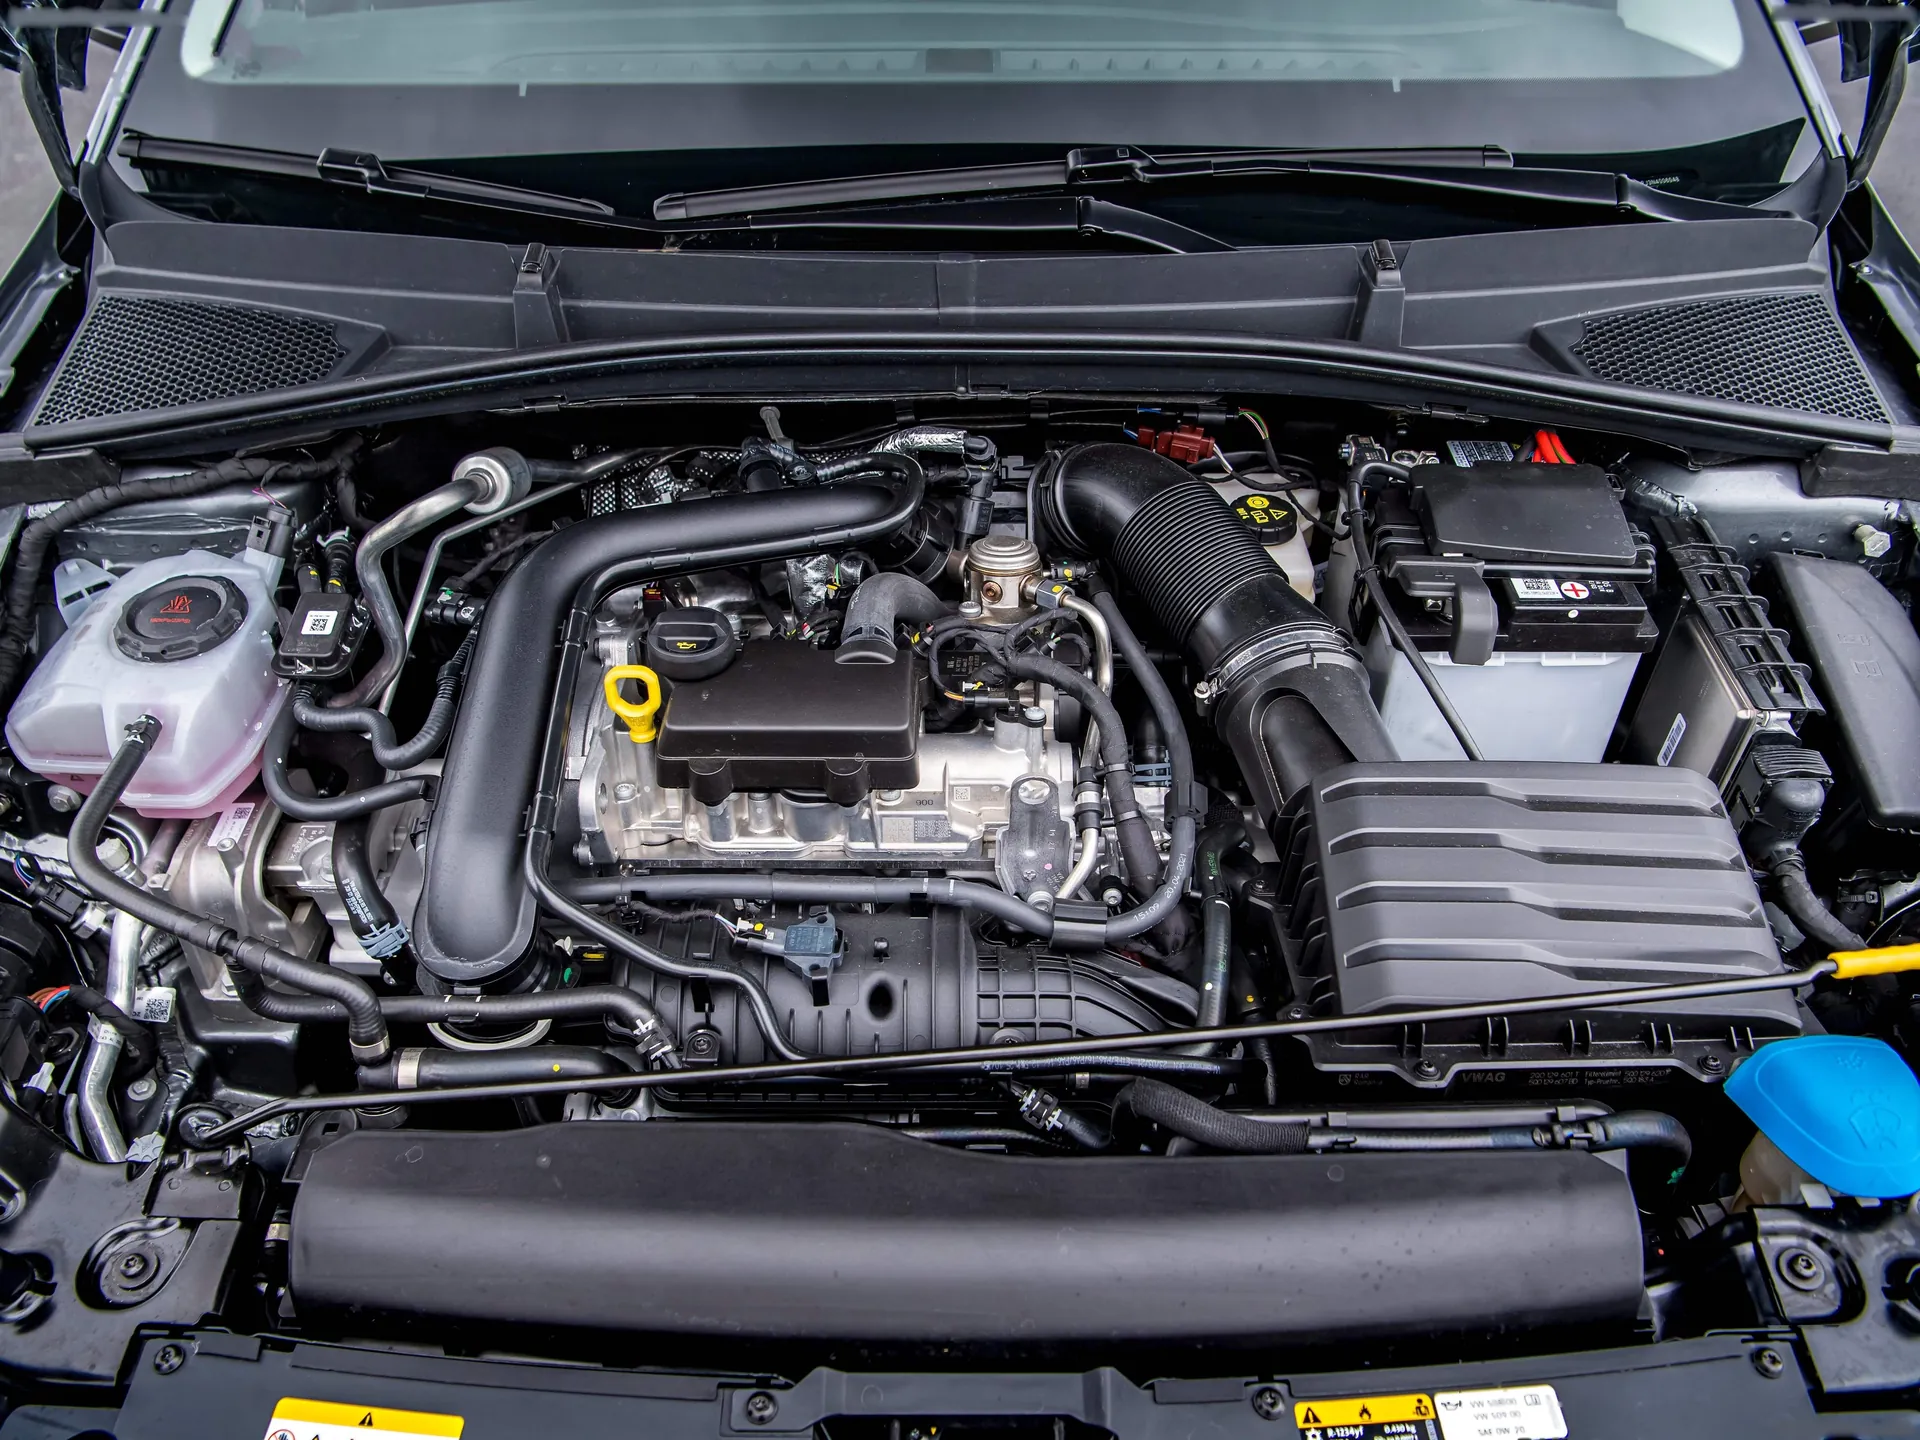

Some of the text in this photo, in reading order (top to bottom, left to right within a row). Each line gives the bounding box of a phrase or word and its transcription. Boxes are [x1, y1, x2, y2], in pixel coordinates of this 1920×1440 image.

[1133, 902, 1160, 922] 15:09
[1164, 853, 1187, 899] 20.04.2021
[1461, 1072, 1506, 1083] VWAG
[1469, 1400, 1485, 1408] VW
[1473, 1411, 1489, 1420] VW
[1326, 1425, 1364, 1438] R-1234yf
[1406, 1423, 1417, 1434] kg
